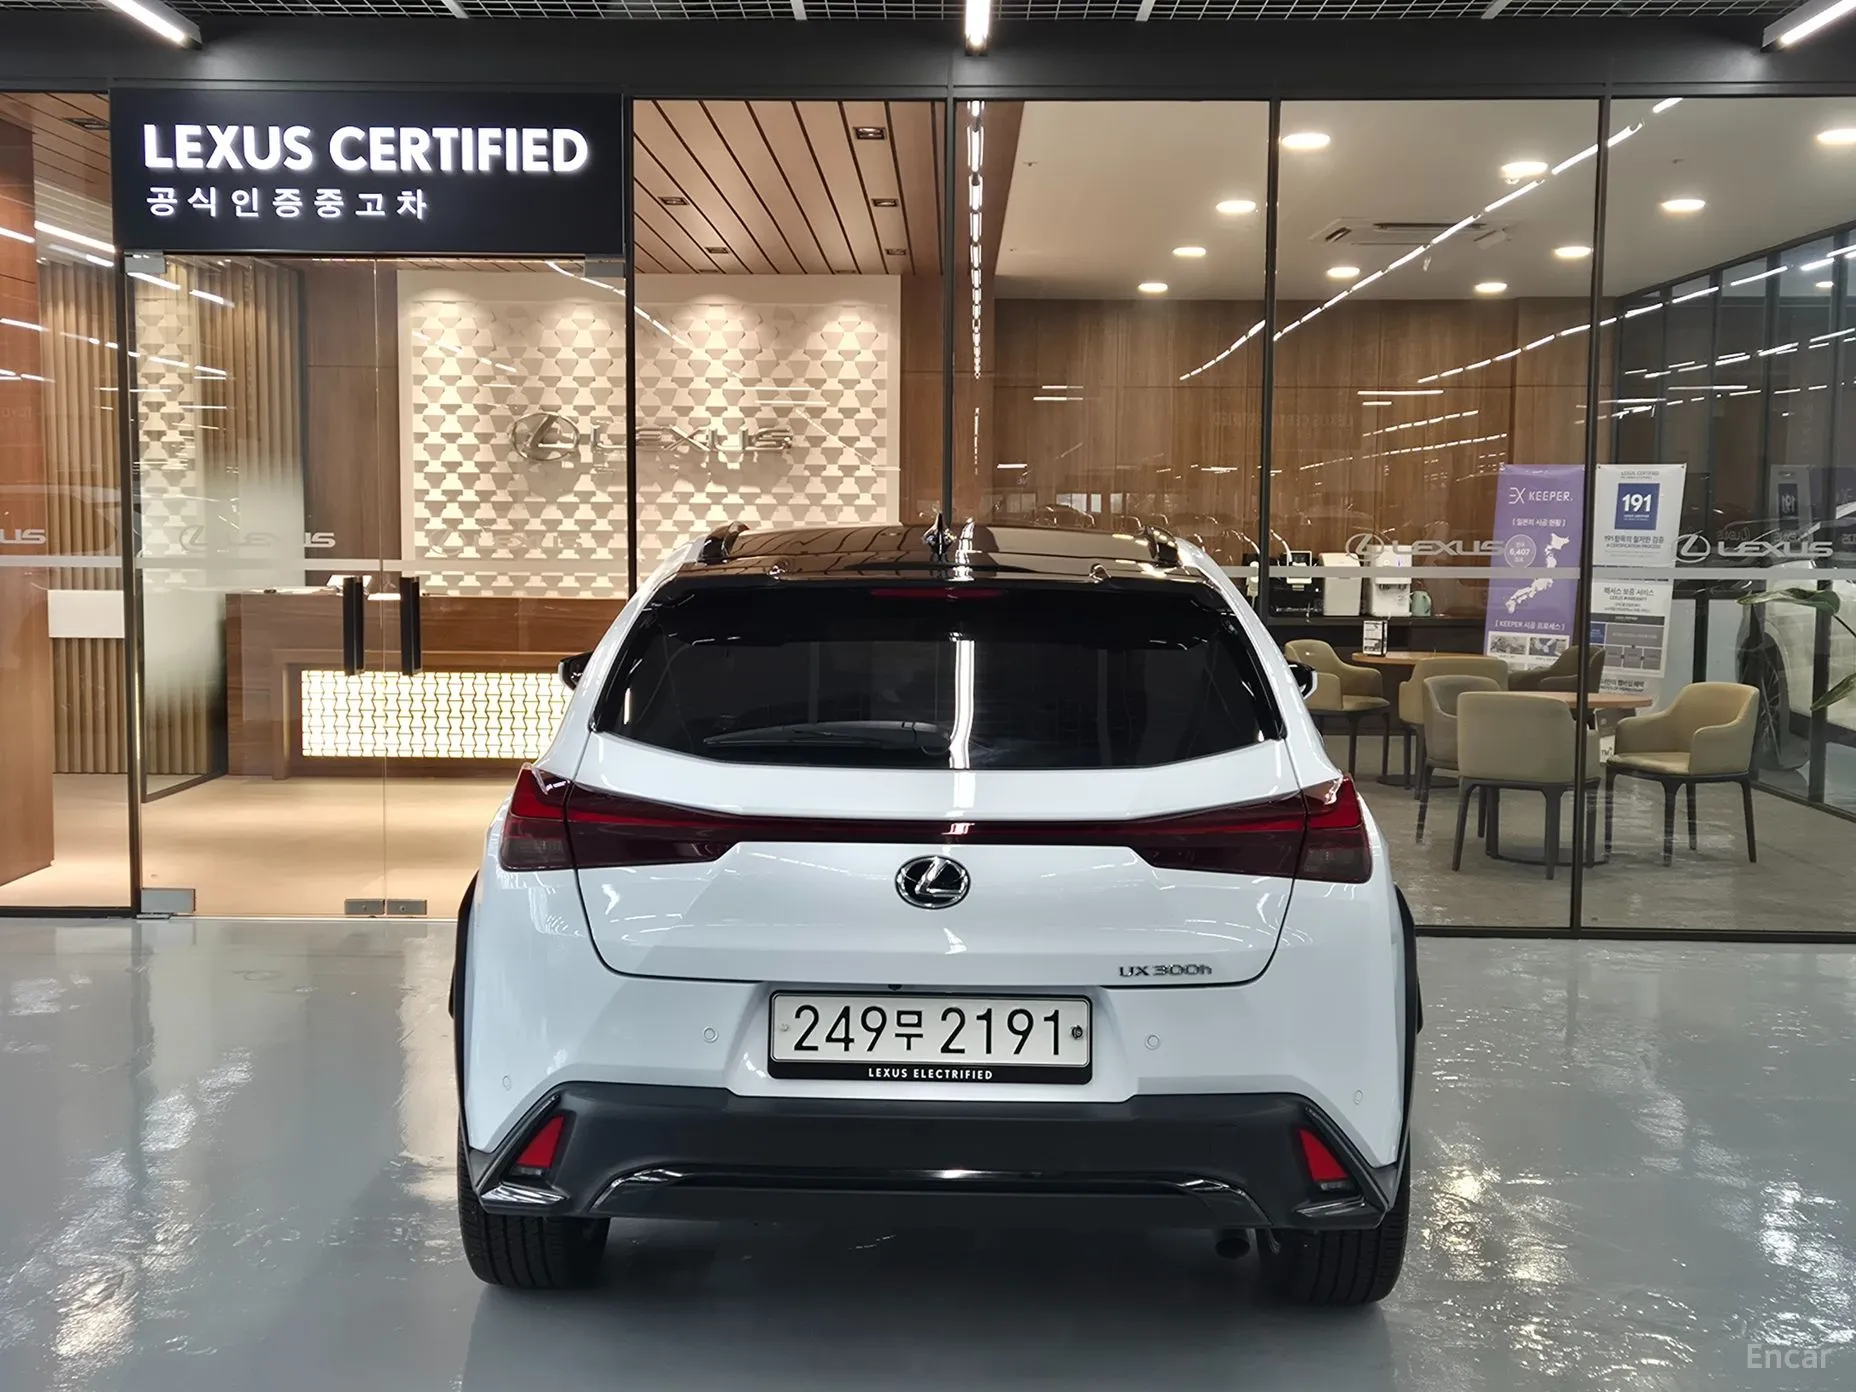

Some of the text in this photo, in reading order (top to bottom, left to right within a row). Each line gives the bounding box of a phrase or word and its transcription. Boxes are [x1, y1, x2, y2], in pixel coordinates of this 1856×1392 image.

[143, 123, 589, 173] LEXUS CERTIFIED
[591, 420, 794, 451] LEXUS
[1622, 493, 1652, 512] 191
[1391, 540, 1504, 556] LEXUS
[1717, 541, 1834, 557] LEXUS
[1119, 963, 1213, 977] UX 300h
[793, 1005, 1060, 1055] 249무 2191
[868, 1068, 993, 1080] LEXUS ELECTRIFIED
